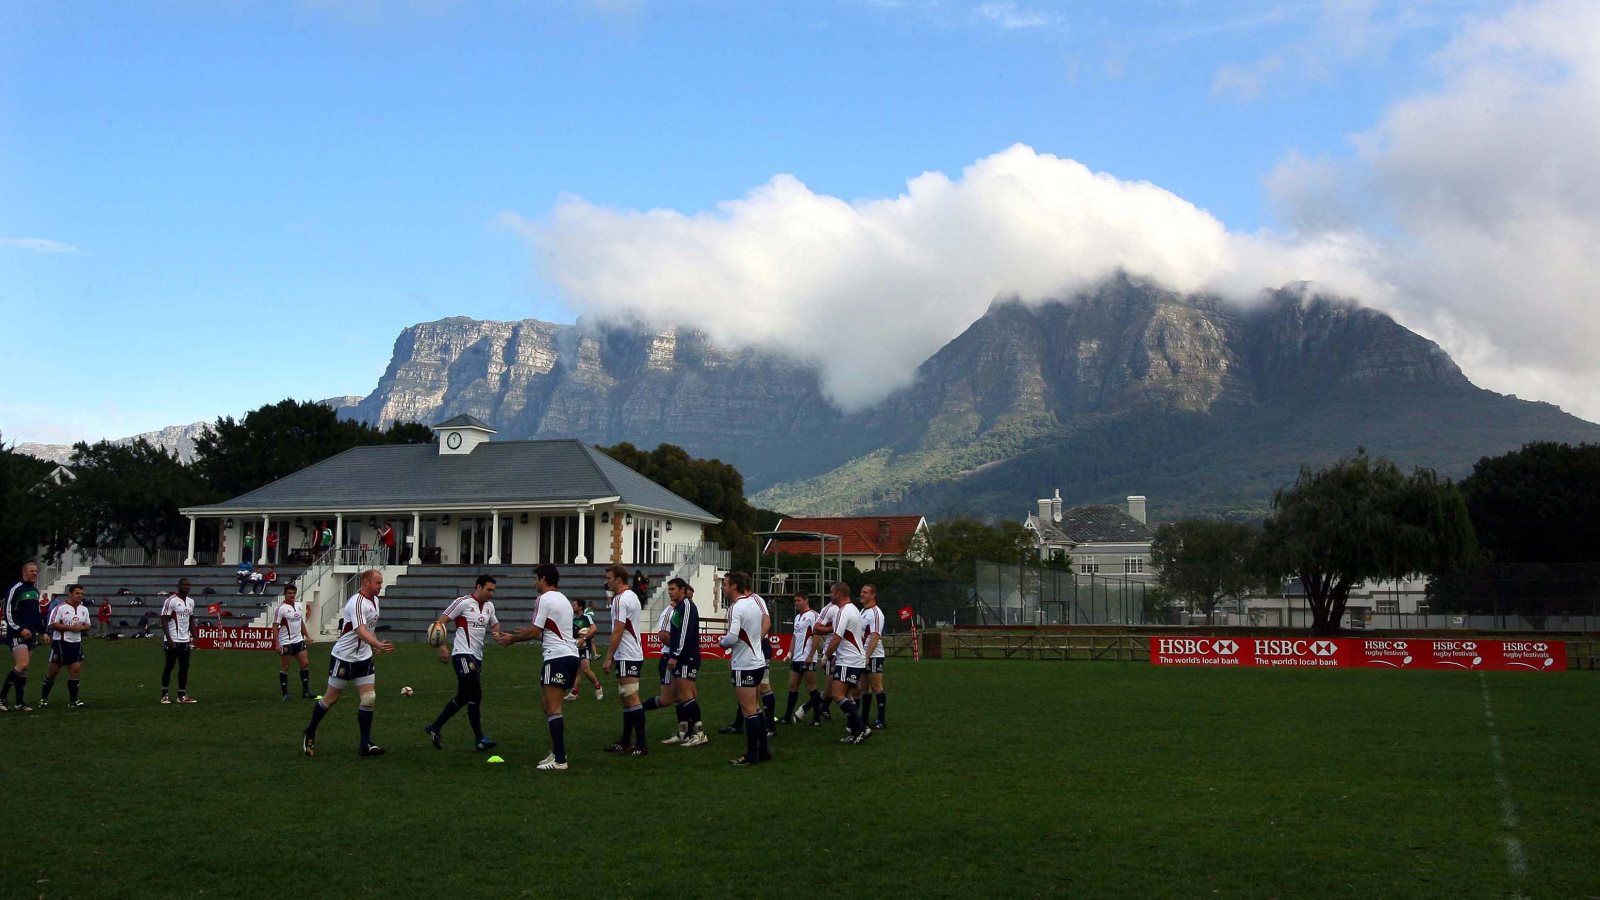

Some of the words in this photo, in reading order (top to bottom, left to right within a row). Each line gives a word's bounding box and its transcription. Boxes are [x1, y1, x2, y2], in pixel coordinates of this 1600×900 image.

[229, 629, 238, 639] &
[240, 629, 261, 640] Irish
[264, 630, 274, 640] Li
[234, 641, 255, 649] Africa
[256, 641, 273, 649] 2009
[1159, 639, 1210, 655] HSBC
[1254, 640, 1307, 656] HSBC
[1365, 641, 1393, 650] HSBC
[1433, 641, 1461, 650] HSBC
[1503, 642, 1532, 652] HSBC
[1160, 656, 1173, 664] The
[1221, 657, 1239, 665] bank
[1255, 657, 1269, 665] The
[1299, 658, 1318, 666] local
[1319, 658, 1338, 666] bank
